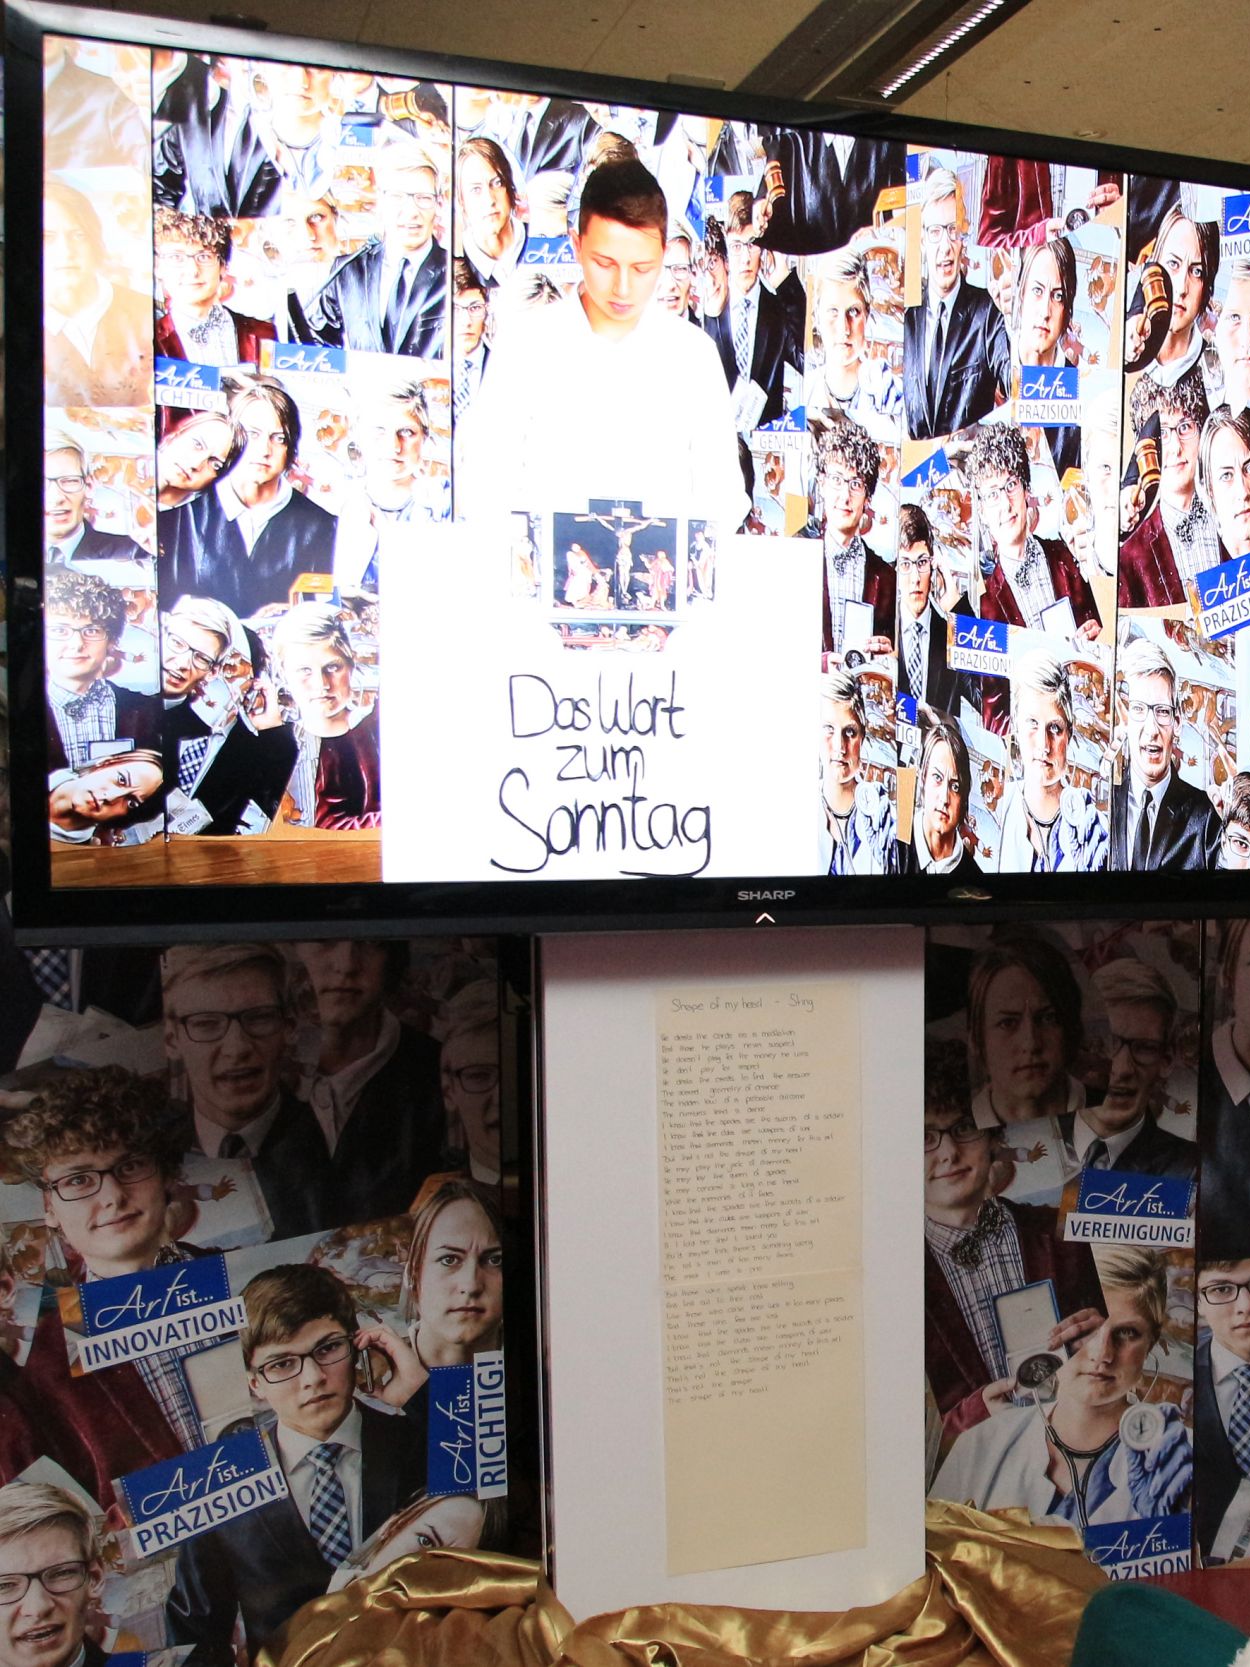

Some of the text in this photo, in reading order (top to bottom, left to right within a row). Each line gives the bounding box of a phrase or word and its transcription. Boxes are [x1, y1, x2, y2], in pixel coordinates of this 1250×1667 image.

[509, 670, 686, 739] Das Wort
[556, 744, 645, 782] zum
[490, 761, 711, 878] Sonntag
[737, 890, 796, 901] SHARP
[671, 998, 704, 1013] Shape
[710, 997, 720, 1010] of
[725, 1000, 739, 1012] my
[788, 992, 815, 1013] Sting
[1071, 1220, 1191, 1243] VEREINIGUNG!
[85, 1303, 245, 1366] INNOVATION!
[477, 1359, 506, 1488] RICHTIG!
[137, 1471, 286, 1552] PRÄZISION!
